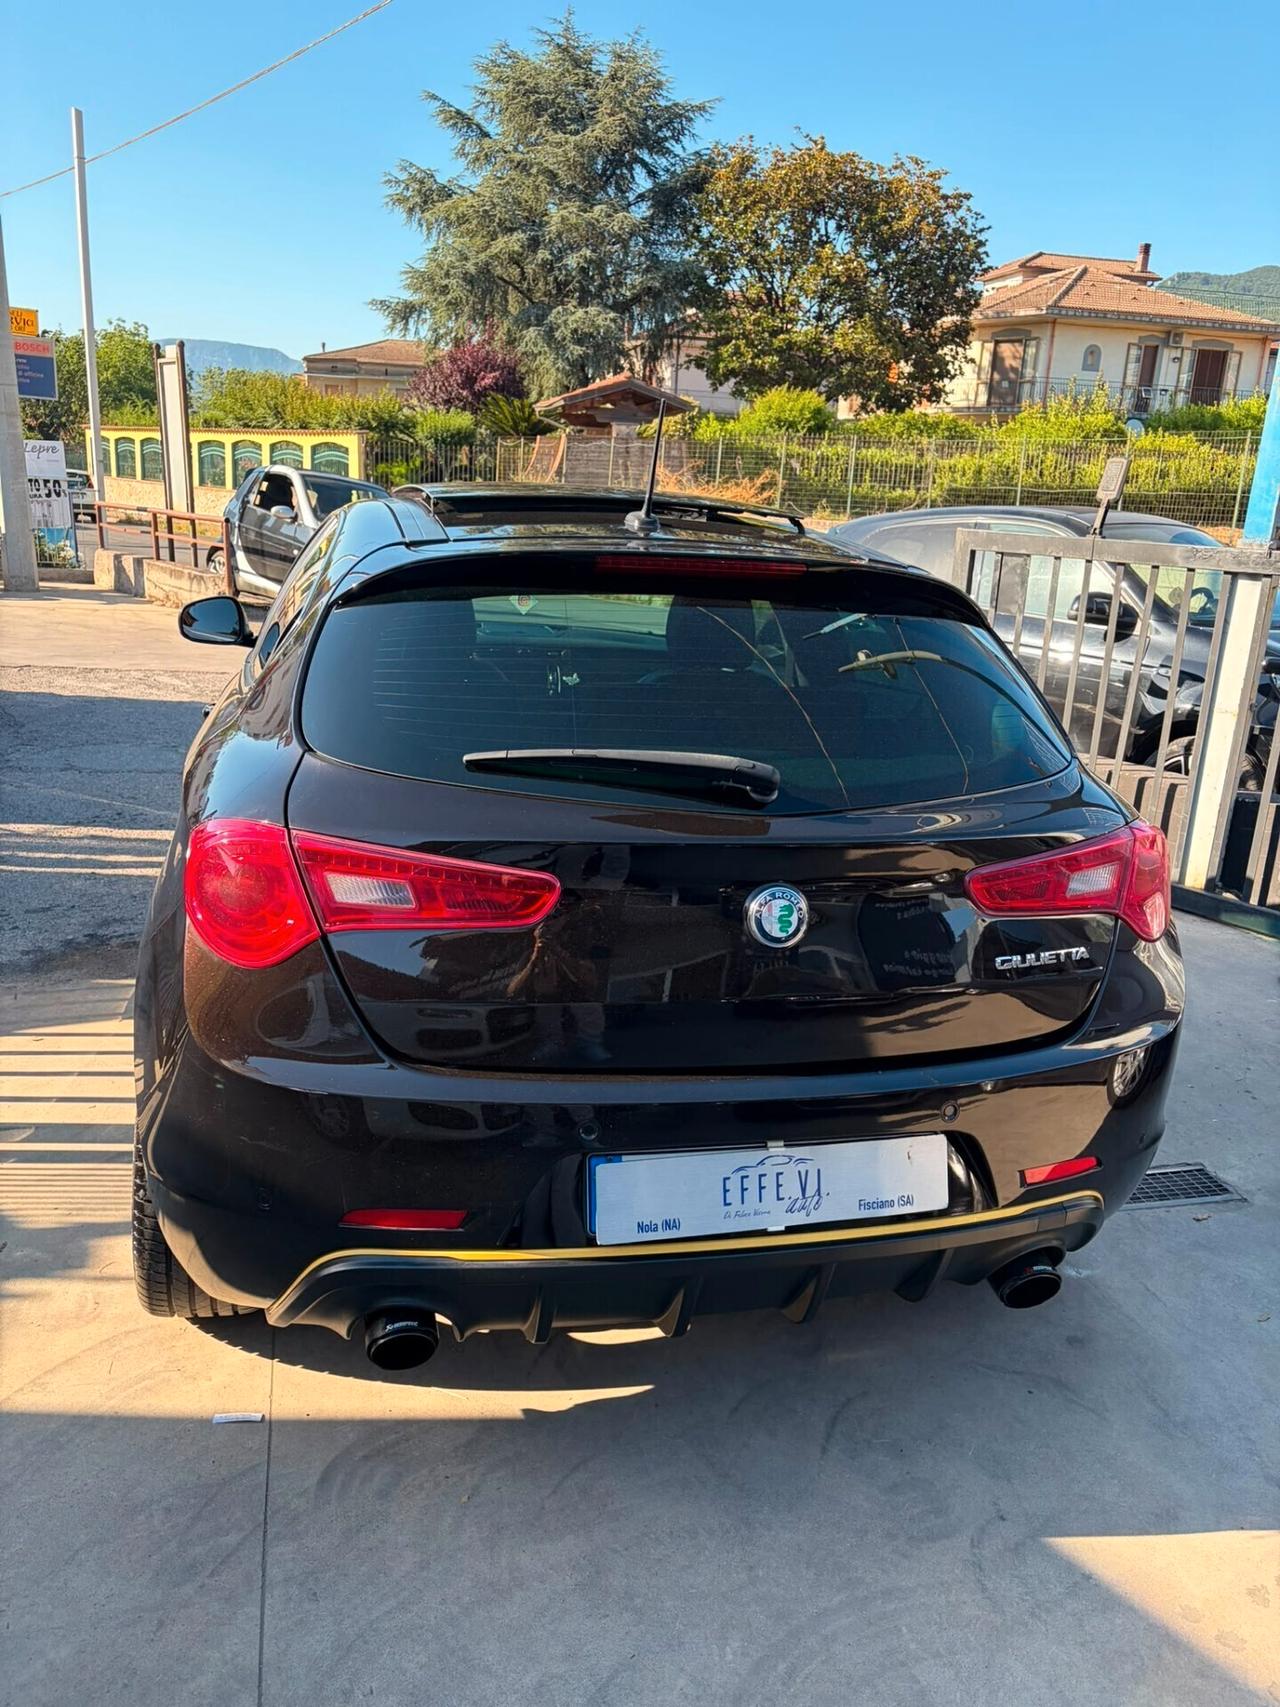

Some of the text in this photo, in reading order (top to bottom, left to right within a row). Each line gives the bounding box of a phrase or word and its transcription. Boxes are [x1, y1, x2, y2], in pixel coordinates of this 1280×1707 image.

[15, 341, 50, 353] BOSCH
[24, 442, 60, 459] Lepre
[755, 892, 804, 919] ALFA ROMEO
[995, 946, 1090, 970] GIULIETTA
[858, 1194, 914, 1211] Fisciano (SA)
[637, 1217, 681, 1234] Nola (NA)
